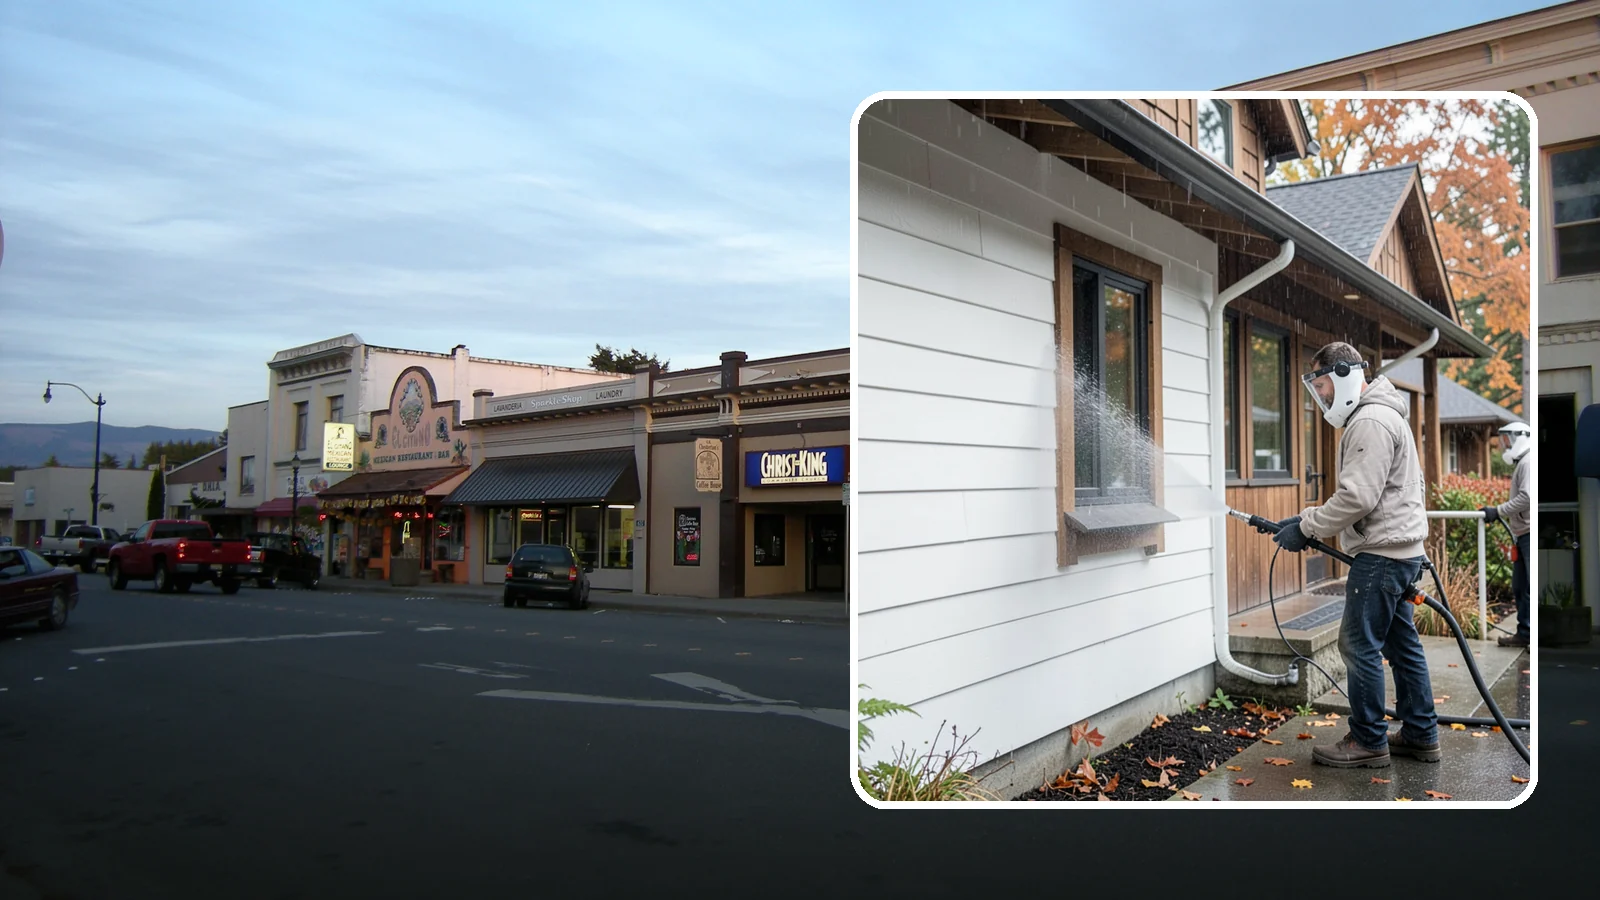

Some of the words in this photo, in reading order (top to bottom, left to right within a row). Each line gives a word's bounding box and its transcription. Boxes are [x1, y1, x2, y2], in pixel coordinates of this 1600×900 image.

[531, 397, 561, 409] Sparkle
[562, 394, 582, 405] Shop
[595, 389, 623, 400] LAUNDRY
[493, 402, 522, 412] LAVANDERIA
[374, 455, 396, 464] MEXICAN
[397, 451, 433, 462] RESTAURANT
[438, 450, 450, 459] BAR
[761, 452, 796, 478] CHRIST
[799, 450, 827, 476] KING
